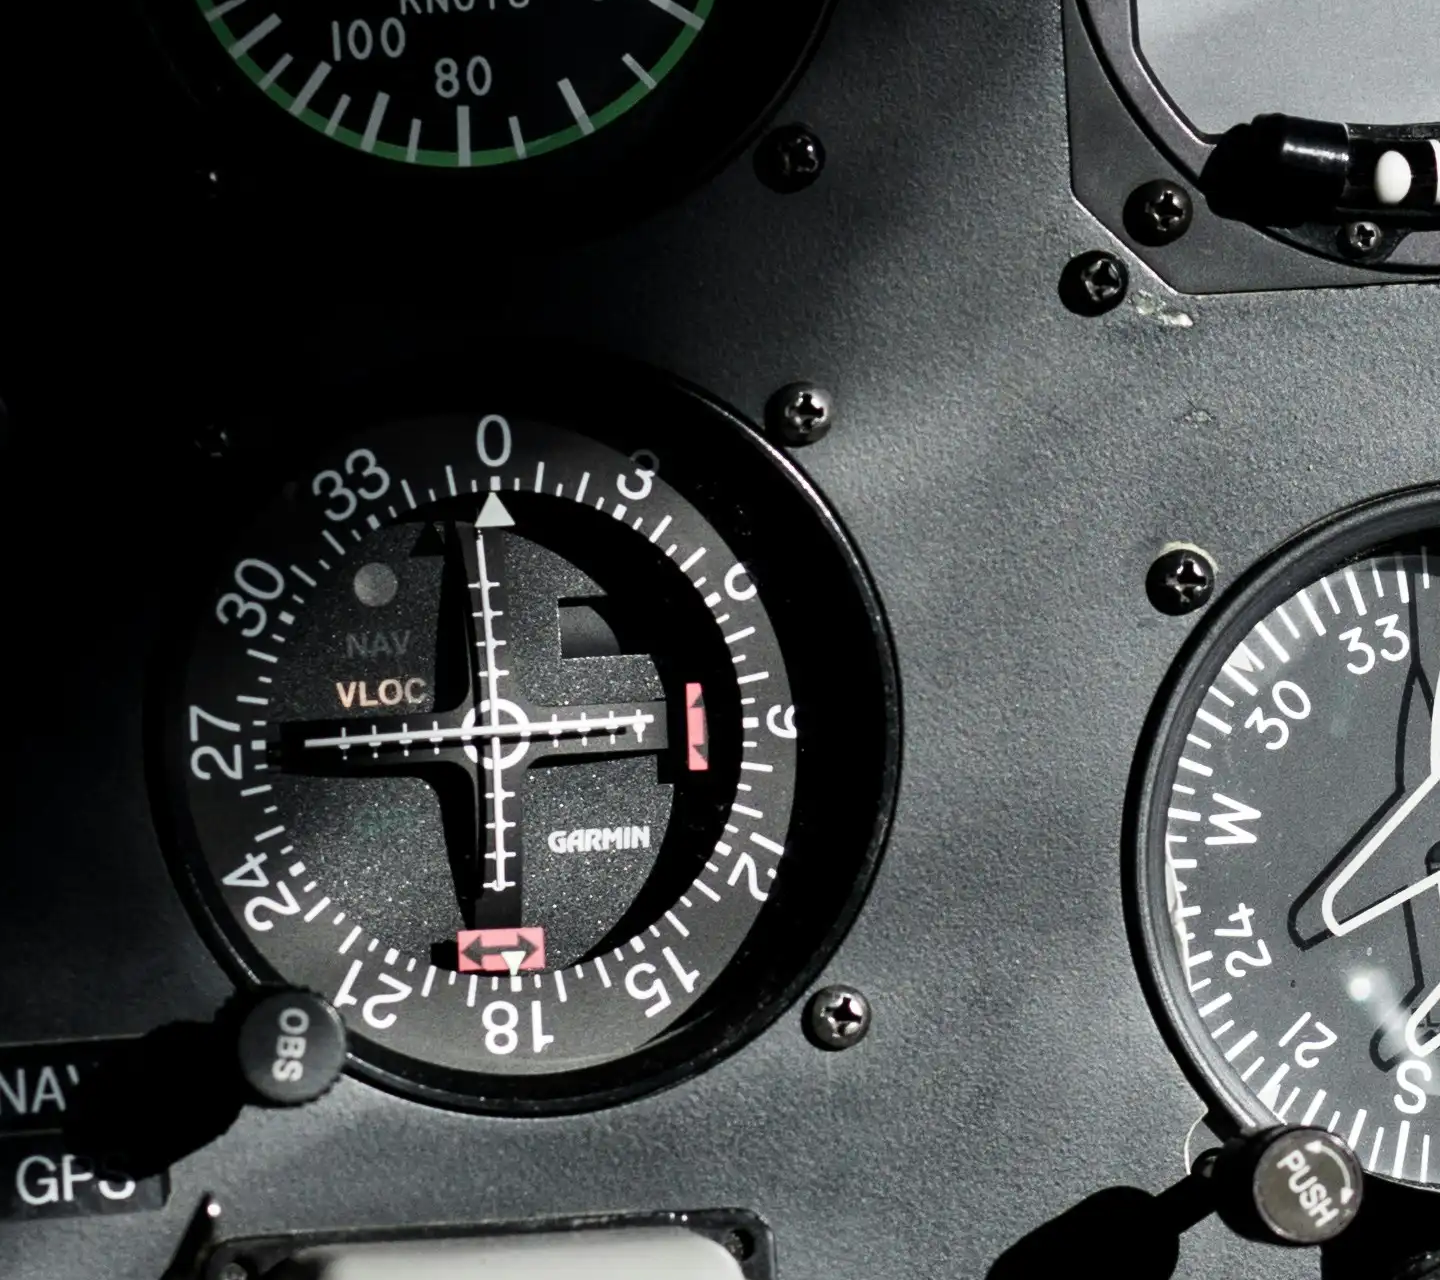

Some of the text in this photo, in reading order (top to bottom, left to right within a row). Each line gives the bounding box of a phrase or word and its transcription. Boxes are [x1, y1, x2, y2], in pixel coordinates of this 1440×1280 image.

[330, 18, 407, 61] 100
[434, 55, 493, 98] 80
[476, 415, 511, 466] 0
[312, 447, 391, 521] 33
[616, 447, 658, 498] 3
[216, 557, 285, 637] 30
[346, 631, 411, 657] NAV
[1339, 615, 1410, 675] 33
[336, 678, 428, 707] VLOC
[1245, 680, 1311, 749] 30
[189, 706, 244, 779] 27
[548, 827, 650, 853] GARMIN
[1205, 794, 1261, 844] W
[222, 852, 301, 931] 24
[726, 835, 785, 902] 12
[1213, 902, 1272, 977] 24
[335, 957, 410, 1028] 21
[625, 947, 701, 1017] 15
[272, 1008, 310, 1082] OBS
[481, 1000, 555, 1053] 18
[1279, 1011, 1338, 1067] 21
[1395, 1060, 1431, 1113] S
[15, 1153, 136, 1205] GPS
[1276, 1149, 1339, 1227] PUSH
